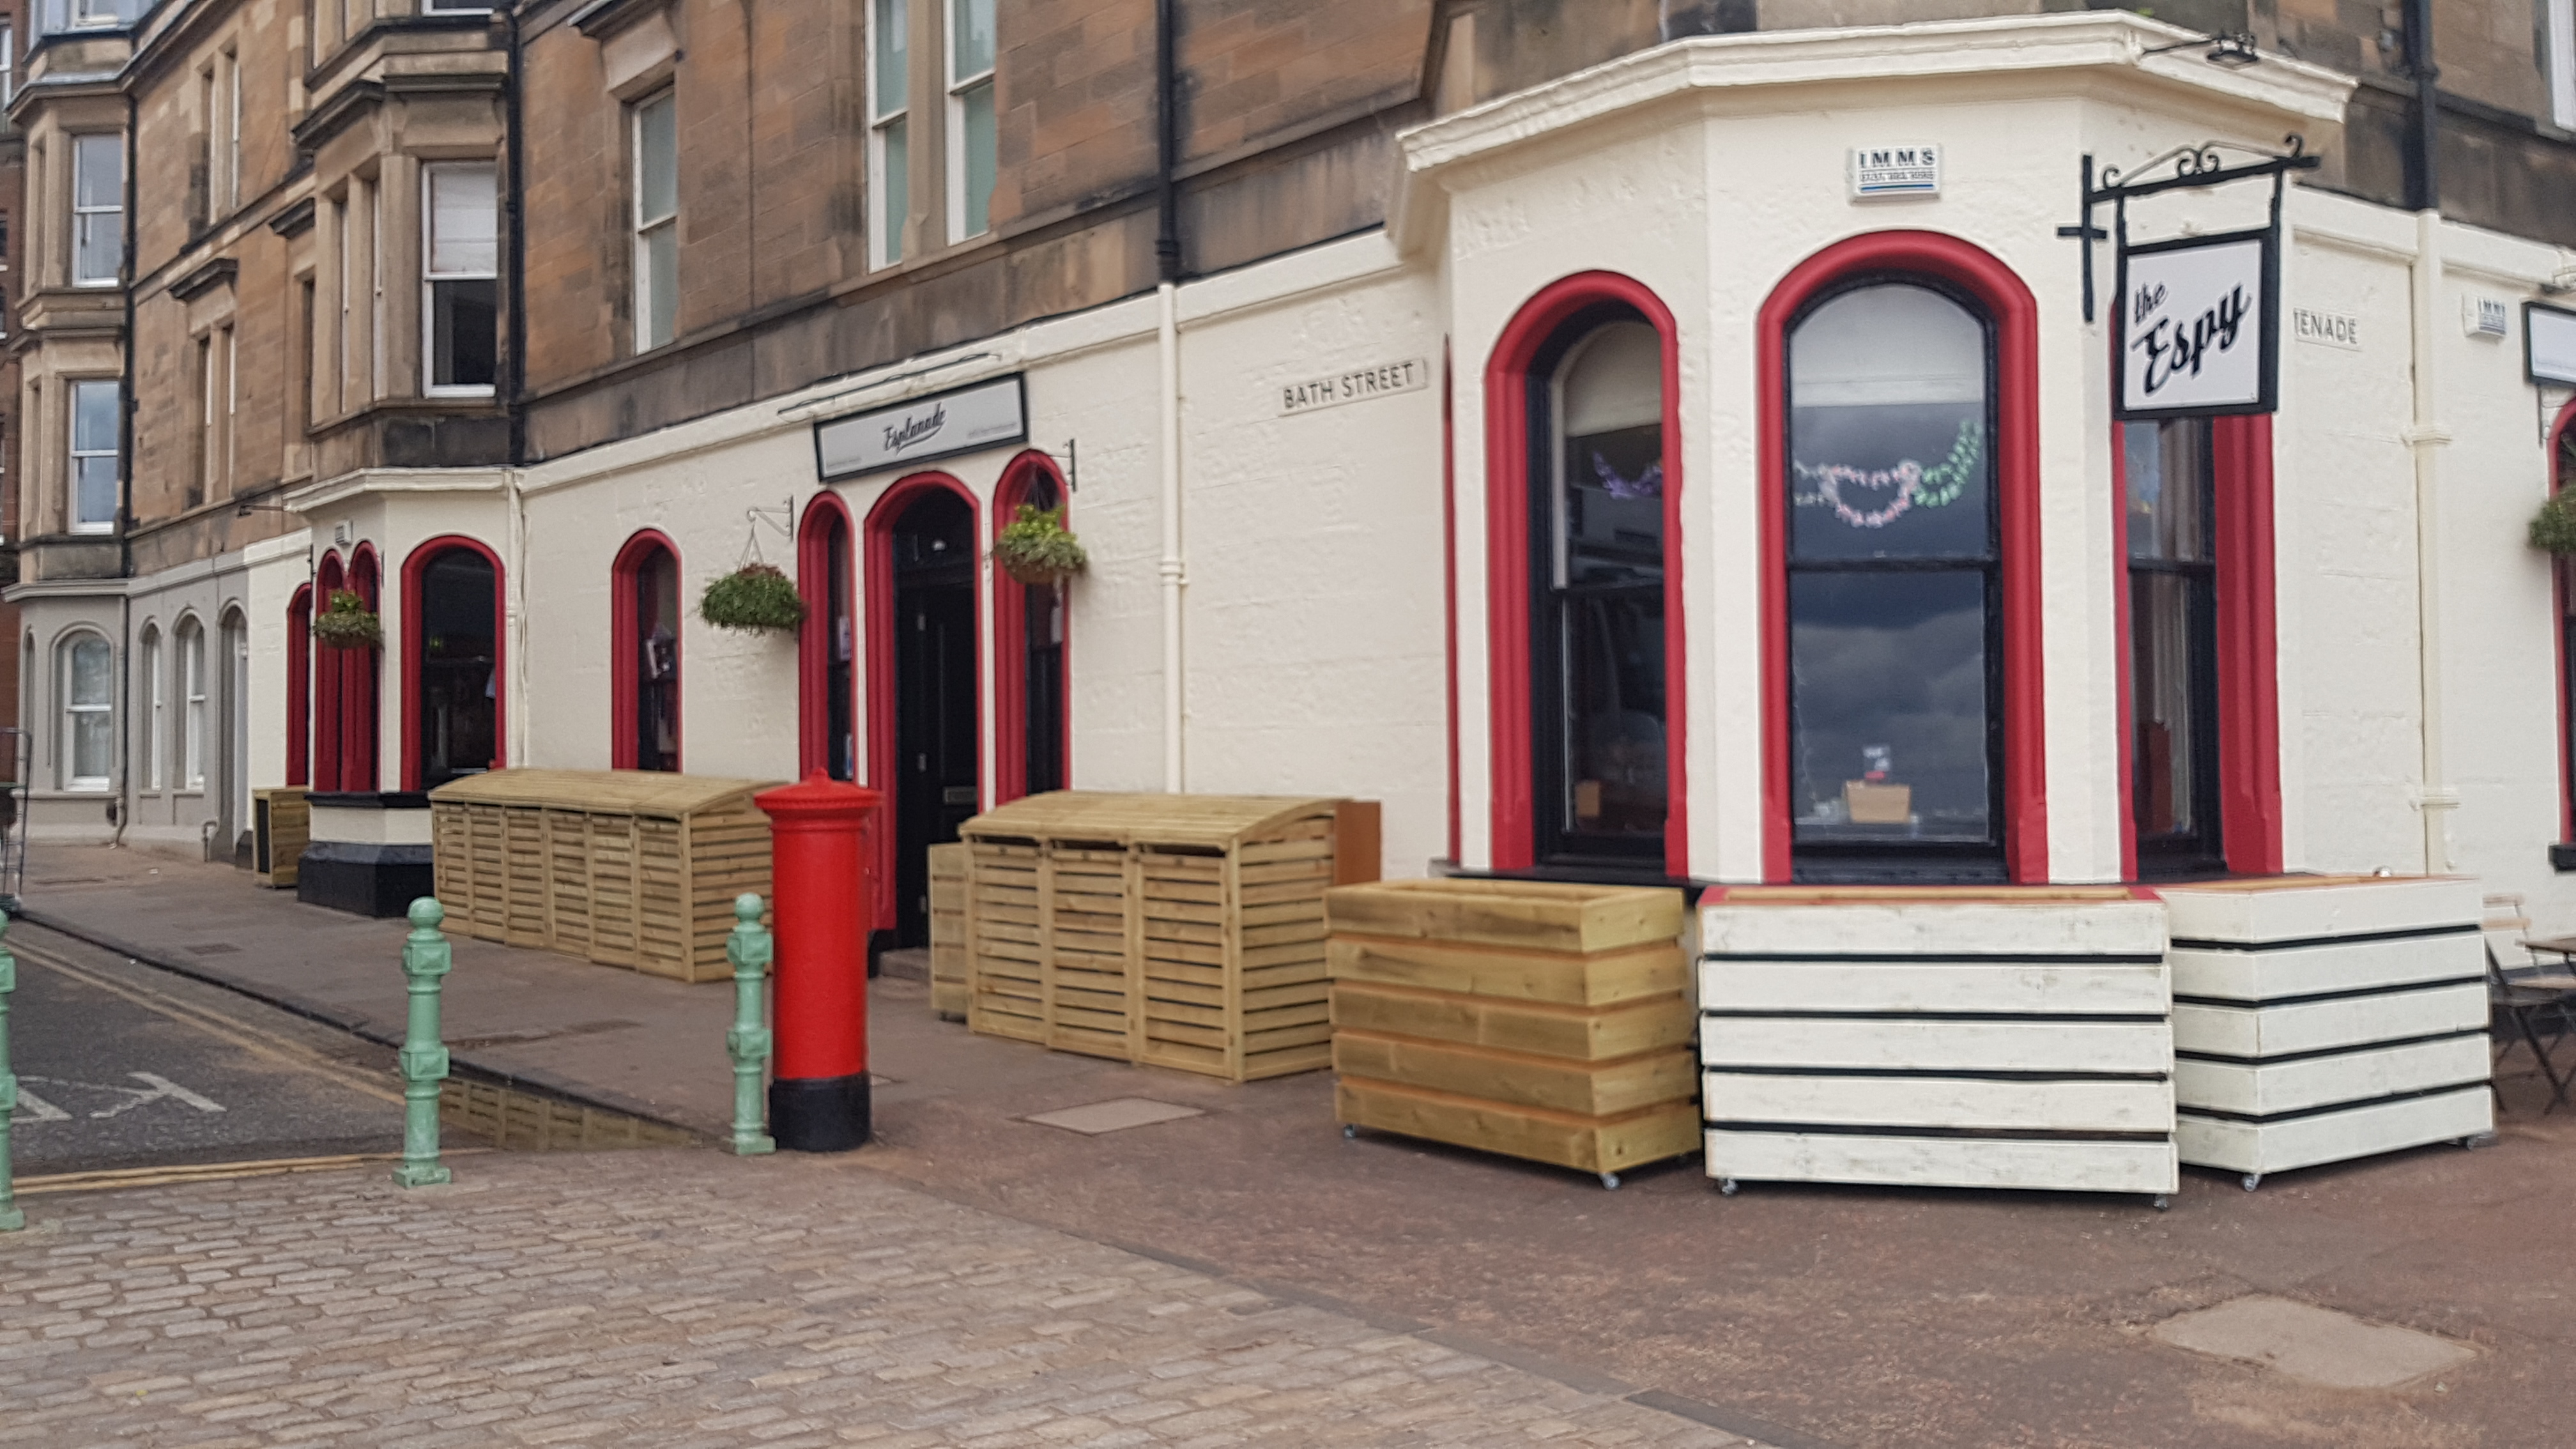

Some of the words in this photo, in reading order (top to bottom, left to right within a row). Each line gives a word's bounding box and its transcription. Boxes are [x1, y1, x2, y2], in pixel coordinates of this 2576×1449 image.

[1860, 147, 1936, 169] IMMS
[2134, 282, 2168, 326] the
[2131, 284, 2252, 394] Espy
[1283, 381, 1333, 409] BATH
[1342, 362, 1414, 398] STREET
